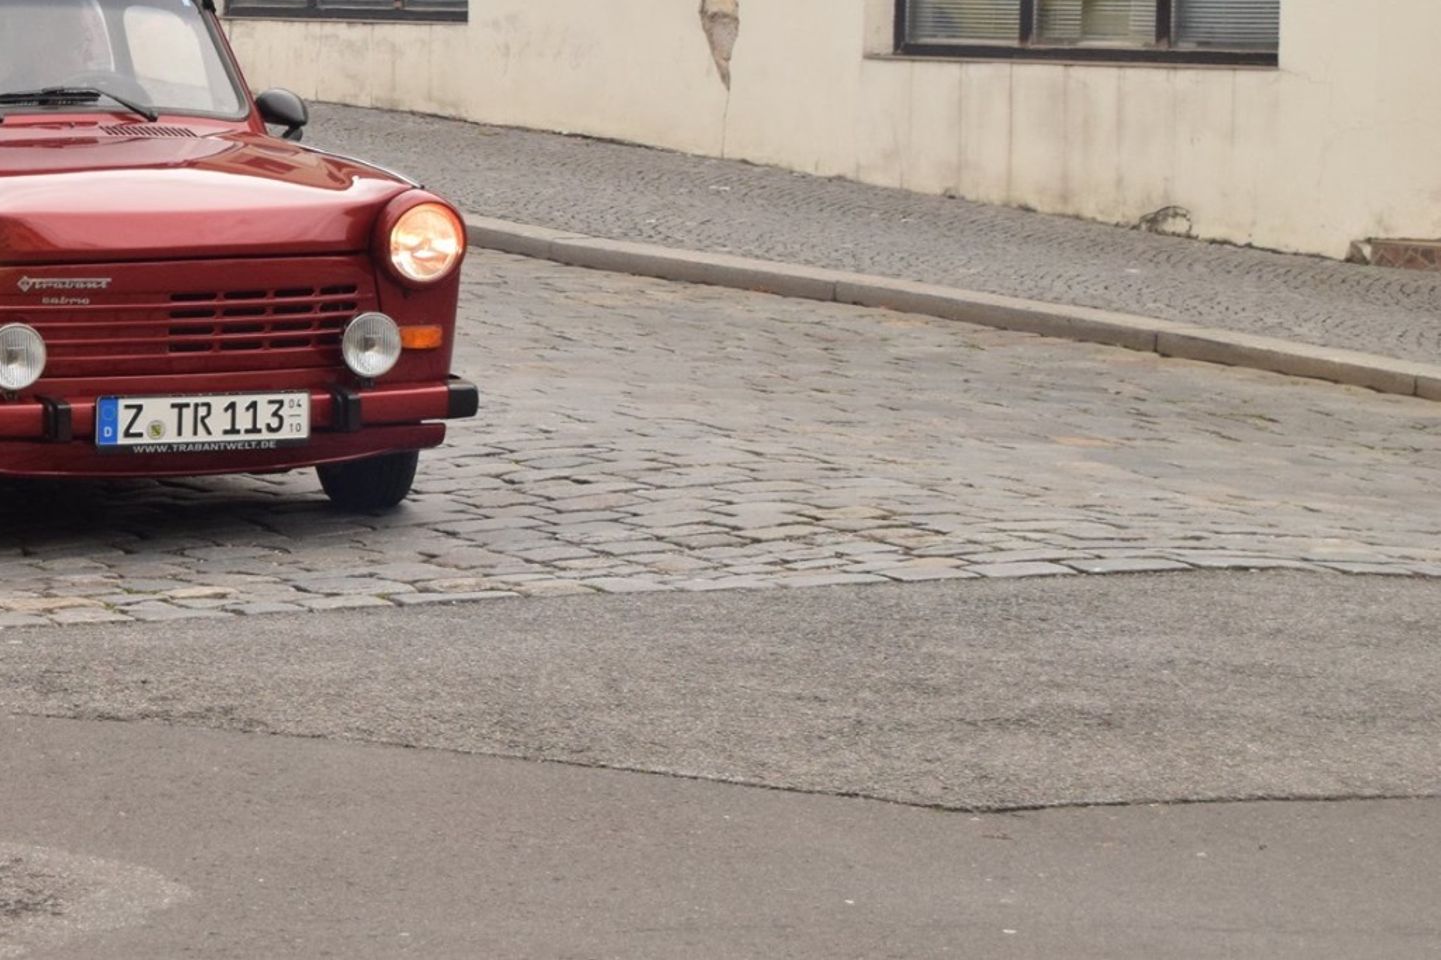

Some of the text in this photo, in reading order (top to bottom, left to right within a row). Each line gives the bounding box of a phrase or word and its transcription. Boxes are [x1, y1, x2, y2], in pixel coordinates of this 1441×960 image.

[104, 399, 284, 438] D Z TR 113
[133, 440, 277, 453] WWW.TRABANTWELT.DE
